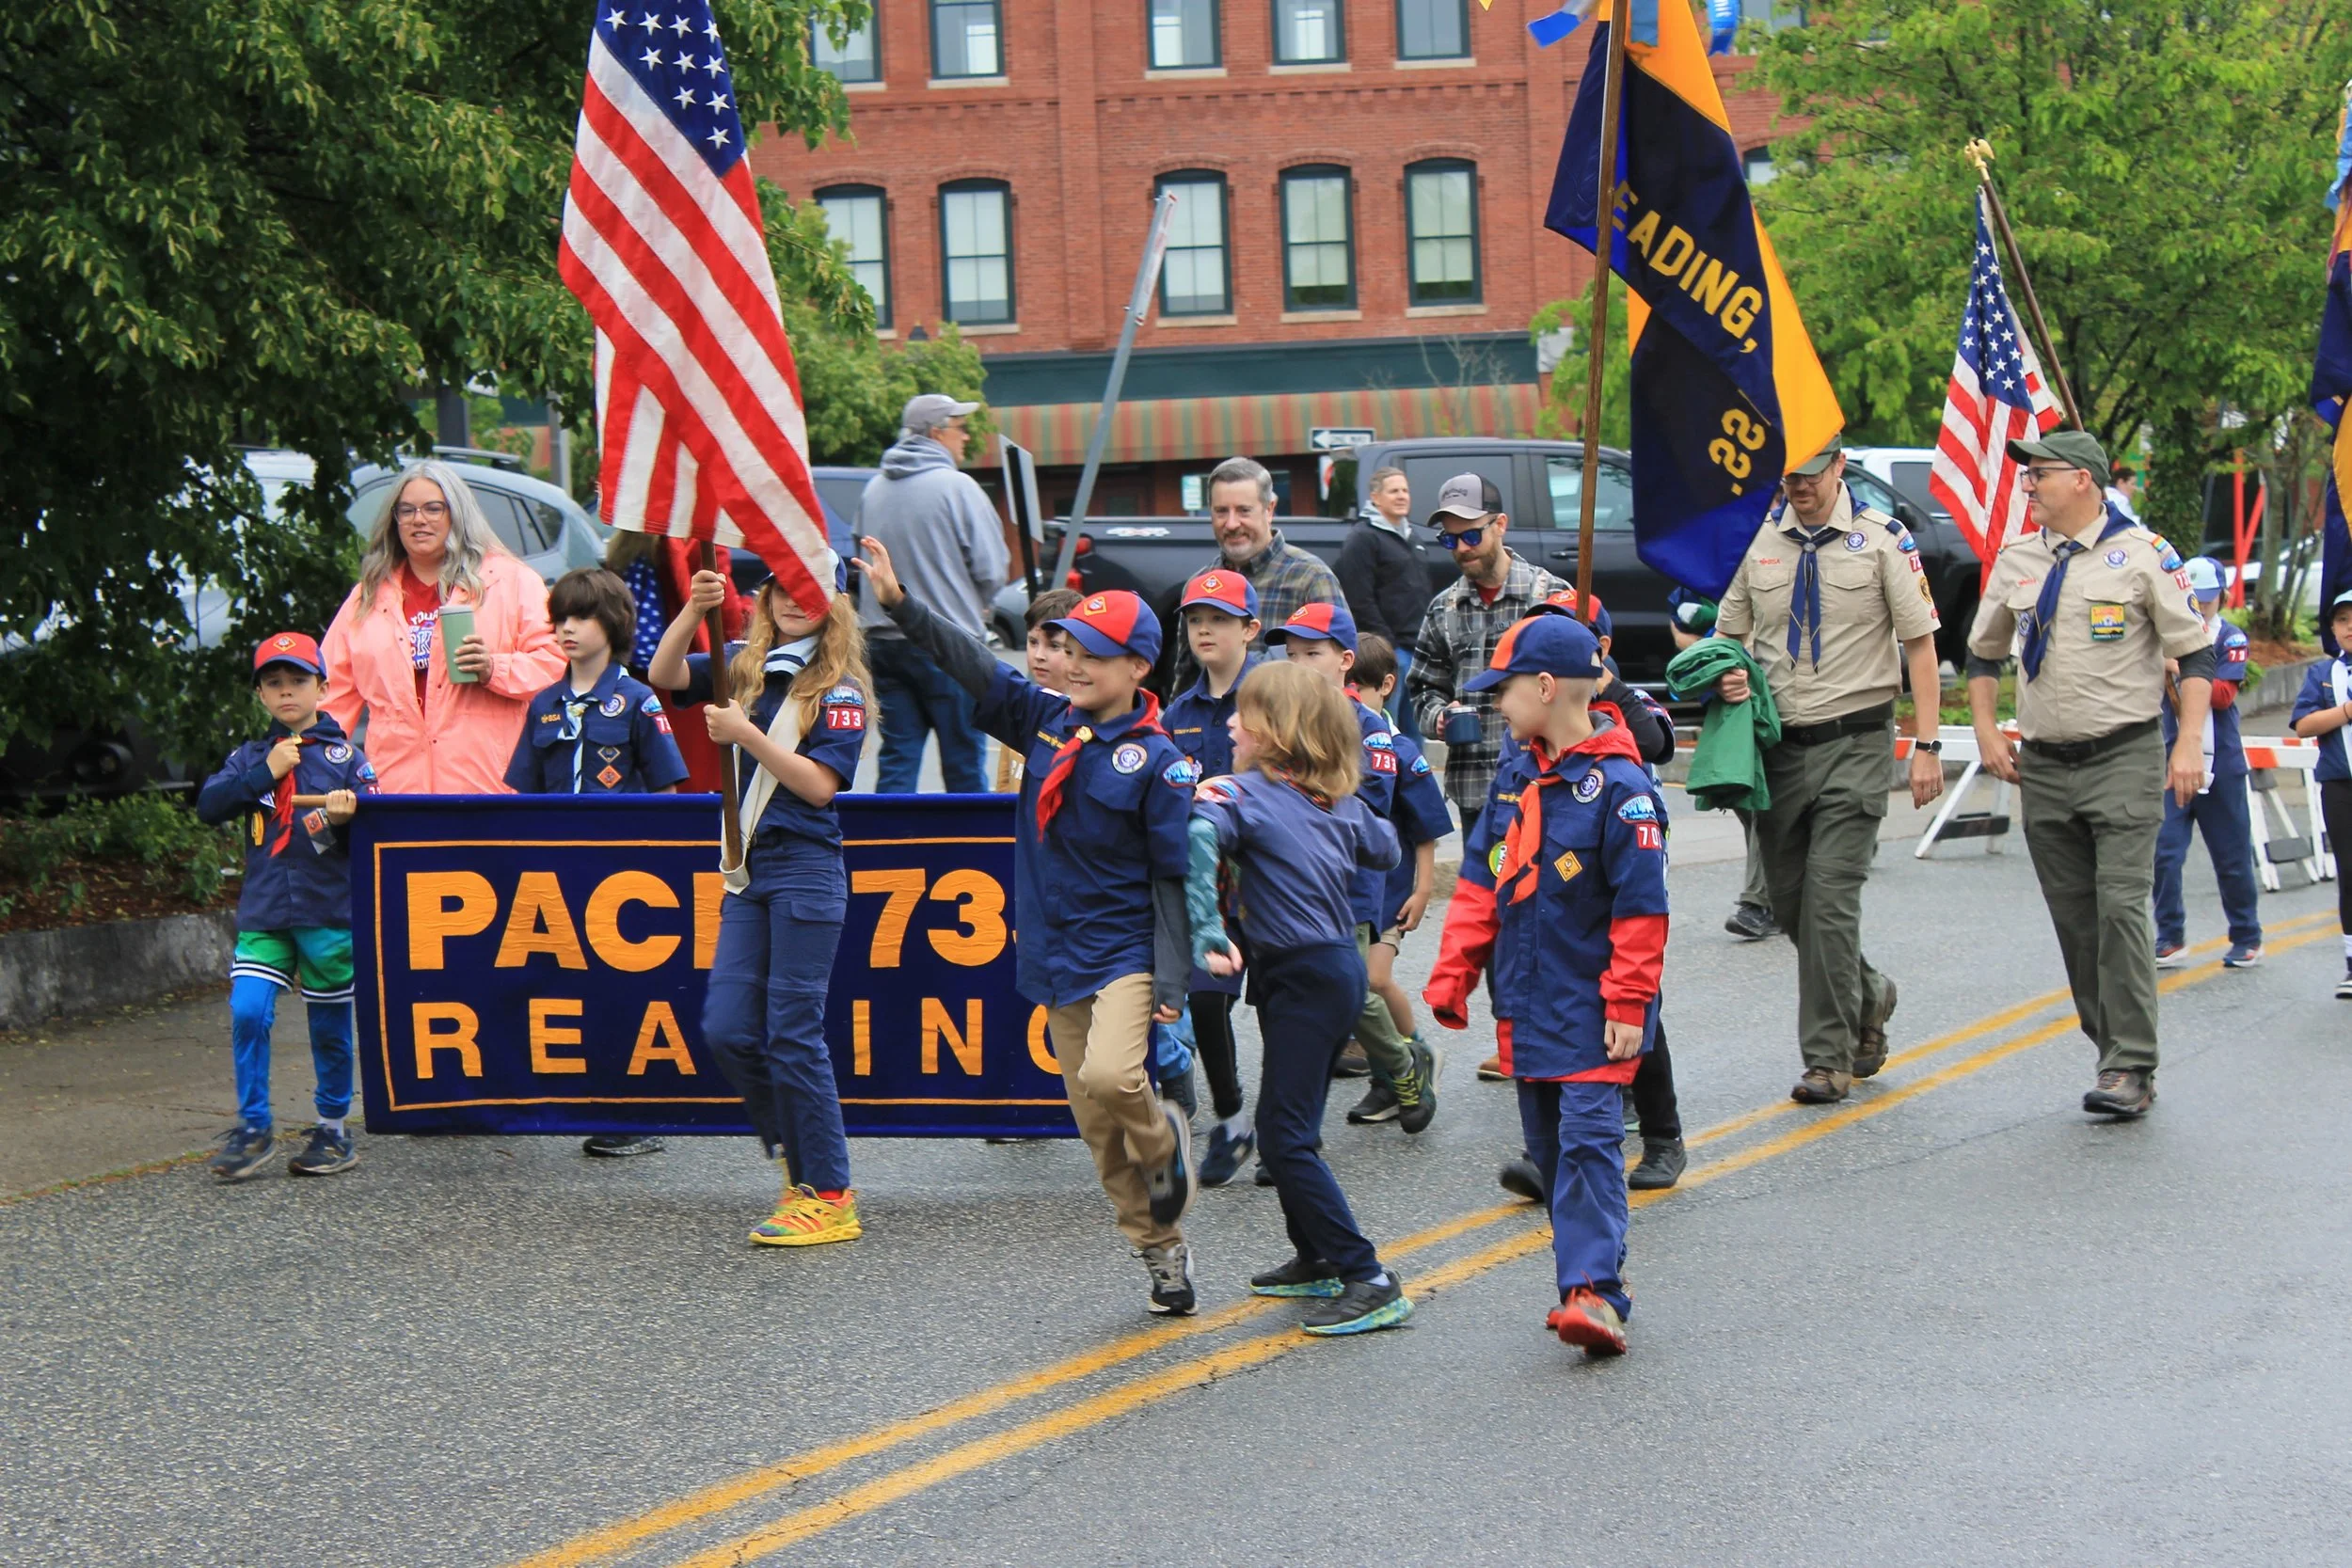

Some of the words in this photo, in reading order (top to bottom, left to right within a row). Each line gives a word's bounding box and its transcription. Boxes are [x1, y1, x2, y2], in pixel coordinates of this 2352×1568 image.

[1612, 181, 1763, 354] EADING,
[829, 710, 862, 727] 733
[1638, 826, 1662, 849] 70
[851, 868, 1017, 967] 73
[412, 998, 1062, 1079] REAIN
